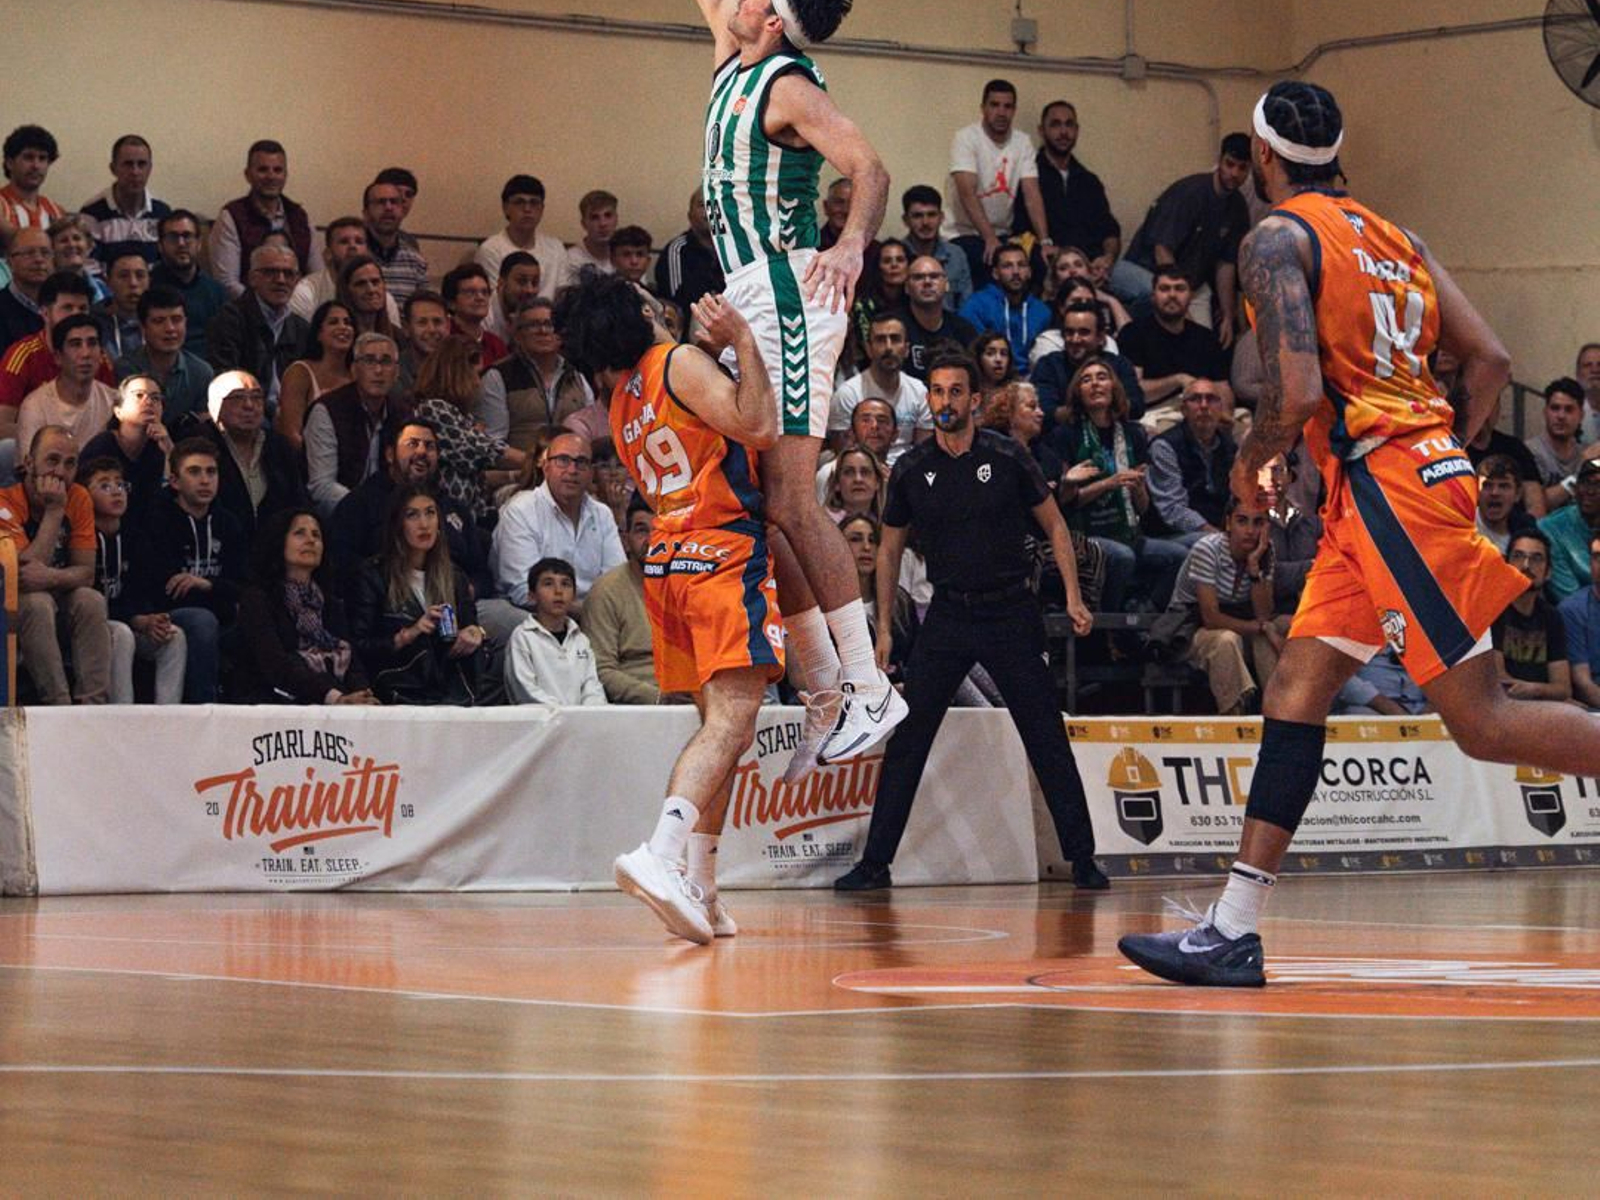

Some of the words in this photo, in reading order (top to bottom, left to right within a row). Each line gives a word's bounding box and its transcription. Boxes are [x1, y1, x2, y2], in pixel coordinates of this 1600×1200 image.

[253, 729, 349, 766] STARLABS
[1320, 757, 1432, 786] CORCA
[194, 755, 400, 840] Trainity
[1331, 787, 1416, 803] CONSTRUCCIÓN
[206, 802, 220, 816] 20
[401, 804, 415, 818] 08
[262, 858, 298, 872] TRAIN.
[301, 858, 322, 873] EAT.
[325, 858, 363, 872] SLEEP.
